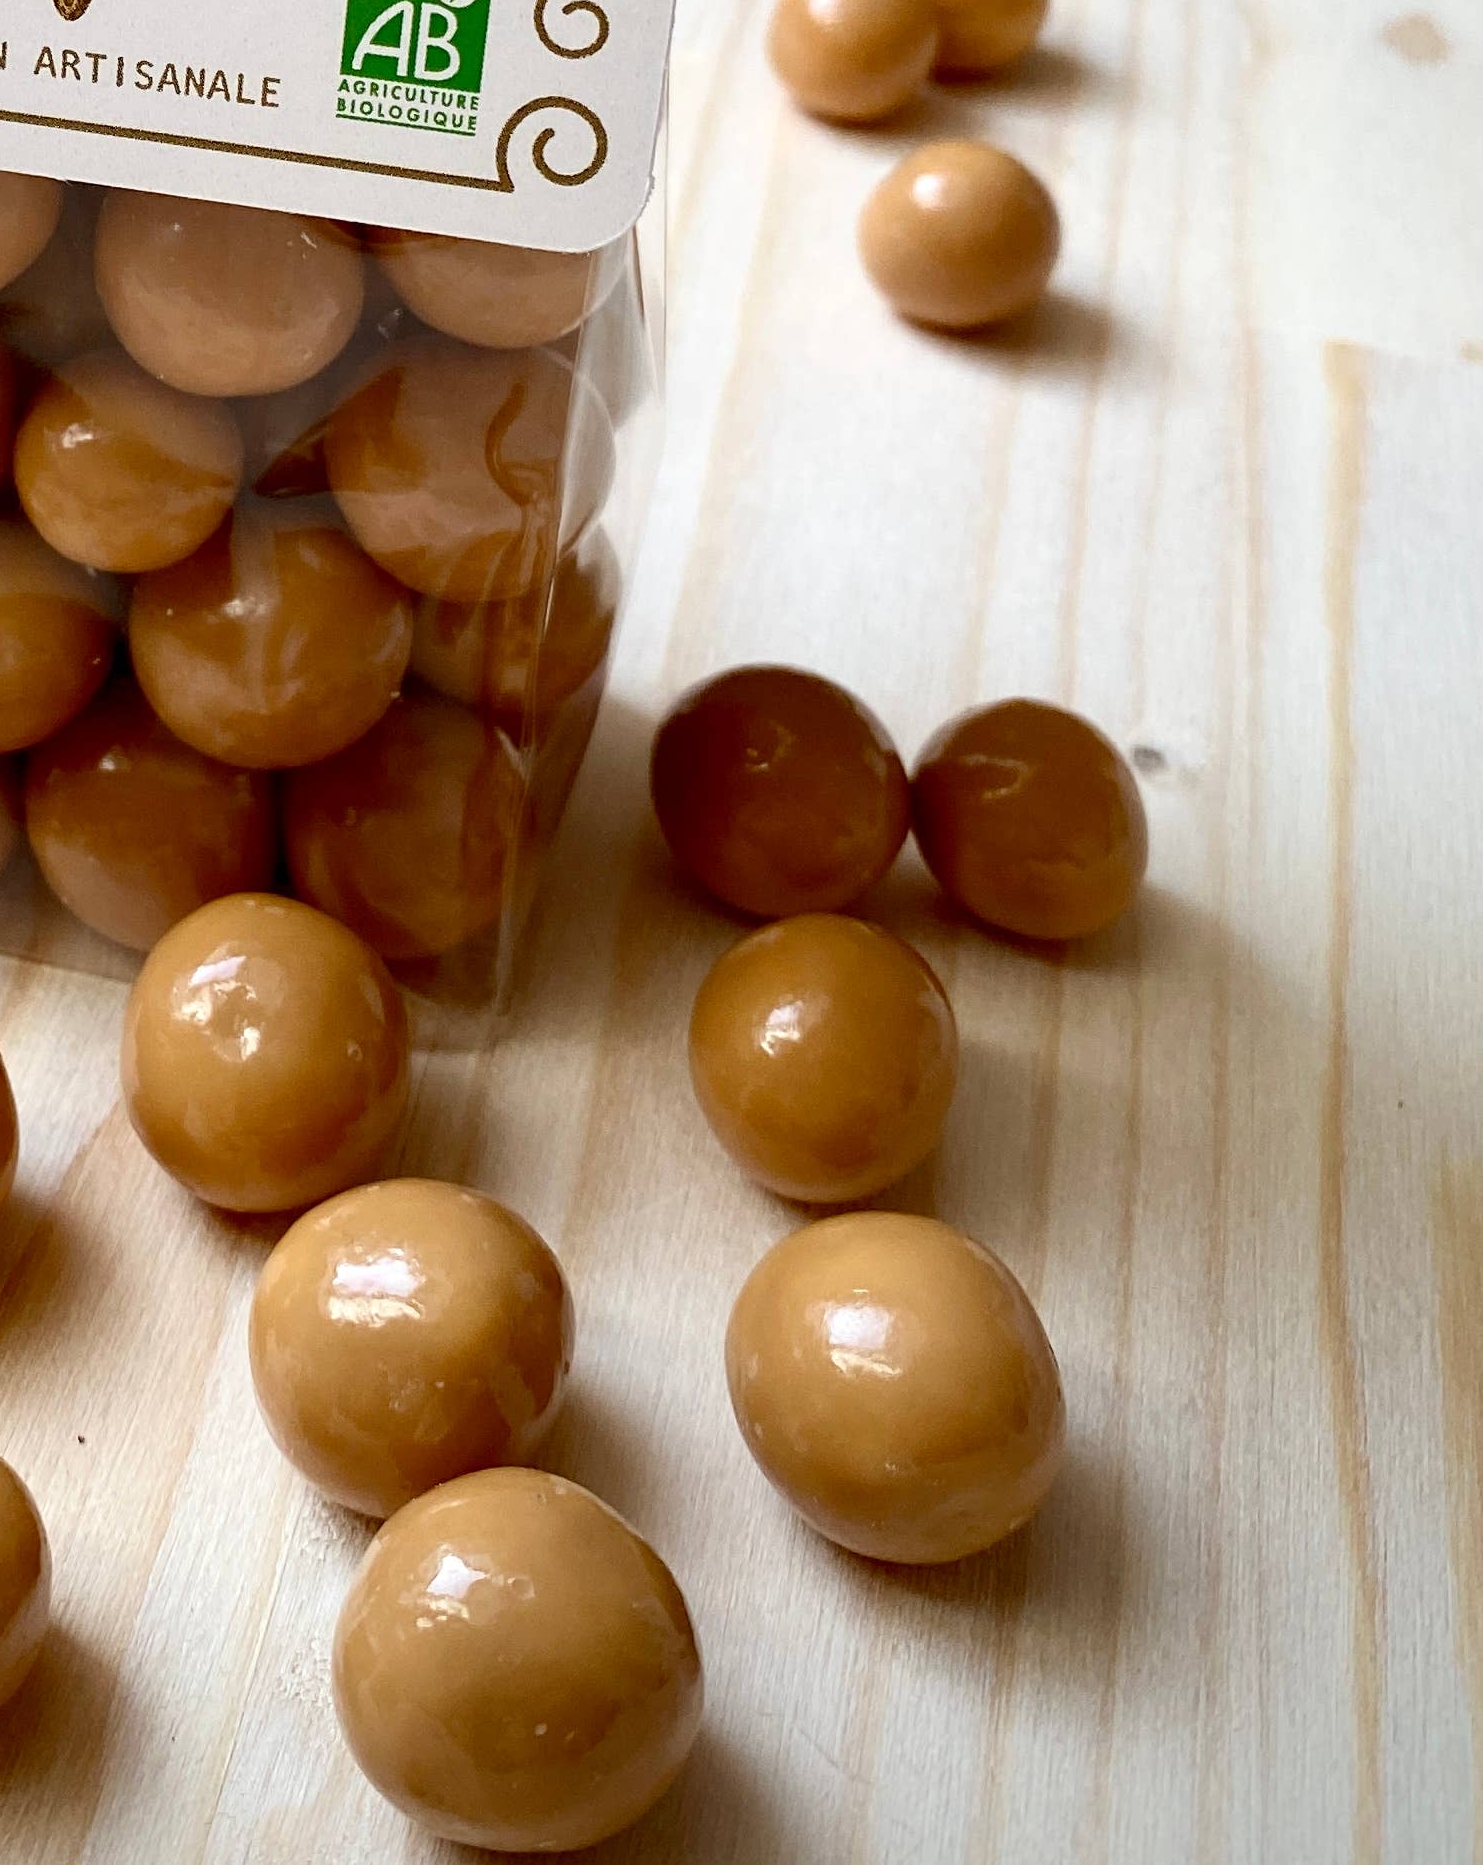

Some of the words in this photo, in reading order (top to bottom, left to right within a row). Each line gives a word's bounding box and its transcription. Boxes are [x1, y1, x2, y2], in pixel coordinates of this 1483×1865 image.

[351, 0, 461, 82] AB
[33, 46, 281, 108] ARTISANALE
[337, 78, 480, 111] AGRICULTURE
[336, 97, 477, 131] BIOLOGIQUE
